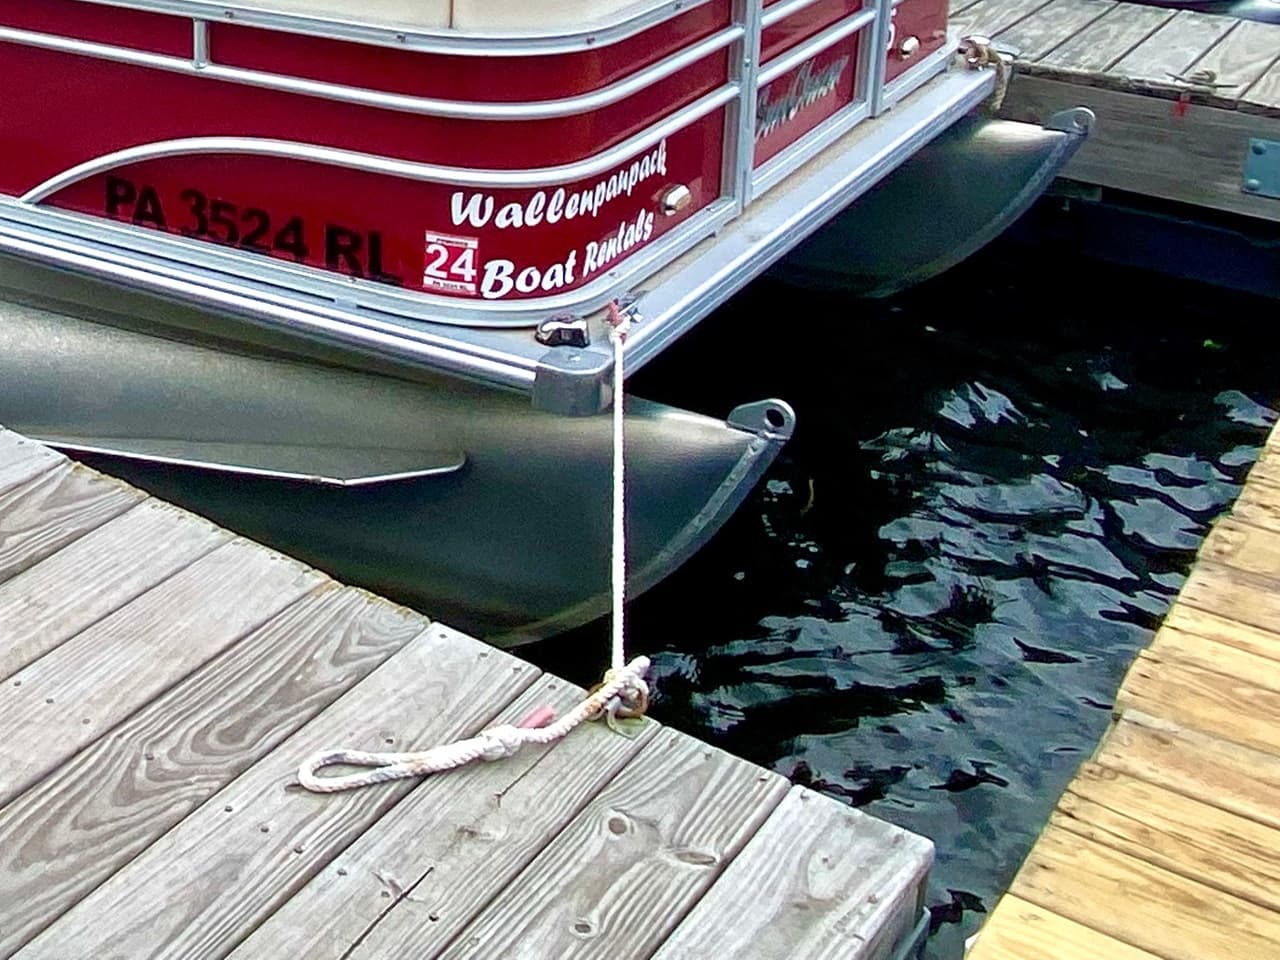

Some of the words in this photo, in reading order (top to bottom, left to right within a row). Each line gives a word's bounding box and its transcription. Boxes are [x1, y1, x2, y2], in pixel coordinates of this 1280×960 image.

[104, 174, 169, 229] PA
[179, 189, 310, 262] 3524
[325, 222, 404, 286] RL
[424, 243, 477, 282] 24
[480, 250, 576, 299] Boat
[582, 208, 654, 277] Rentals
